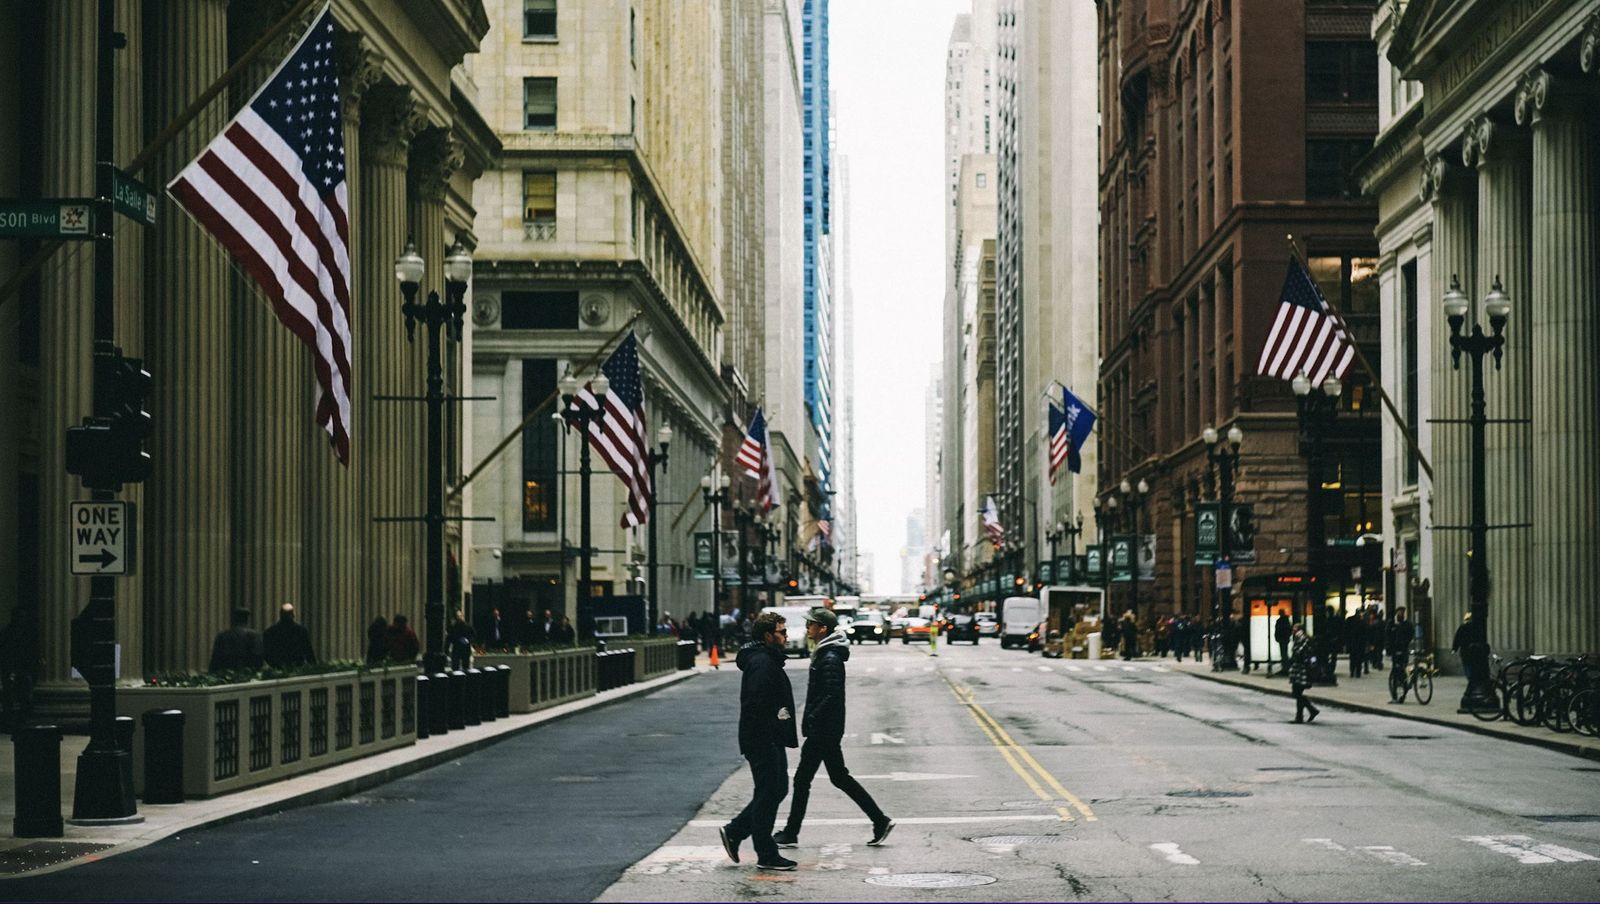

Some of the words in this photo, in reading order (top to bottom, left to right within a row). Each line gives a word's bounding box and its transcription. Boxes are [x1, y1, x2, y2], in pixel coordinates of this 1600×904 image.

[115, 178, 123, 202] La
[124, 185, 142, 211] Salle
[32, 213, 56, 225] Blvd
[77, 507, 120, 525] ONE
[77, 527, 121, 545] WAY
